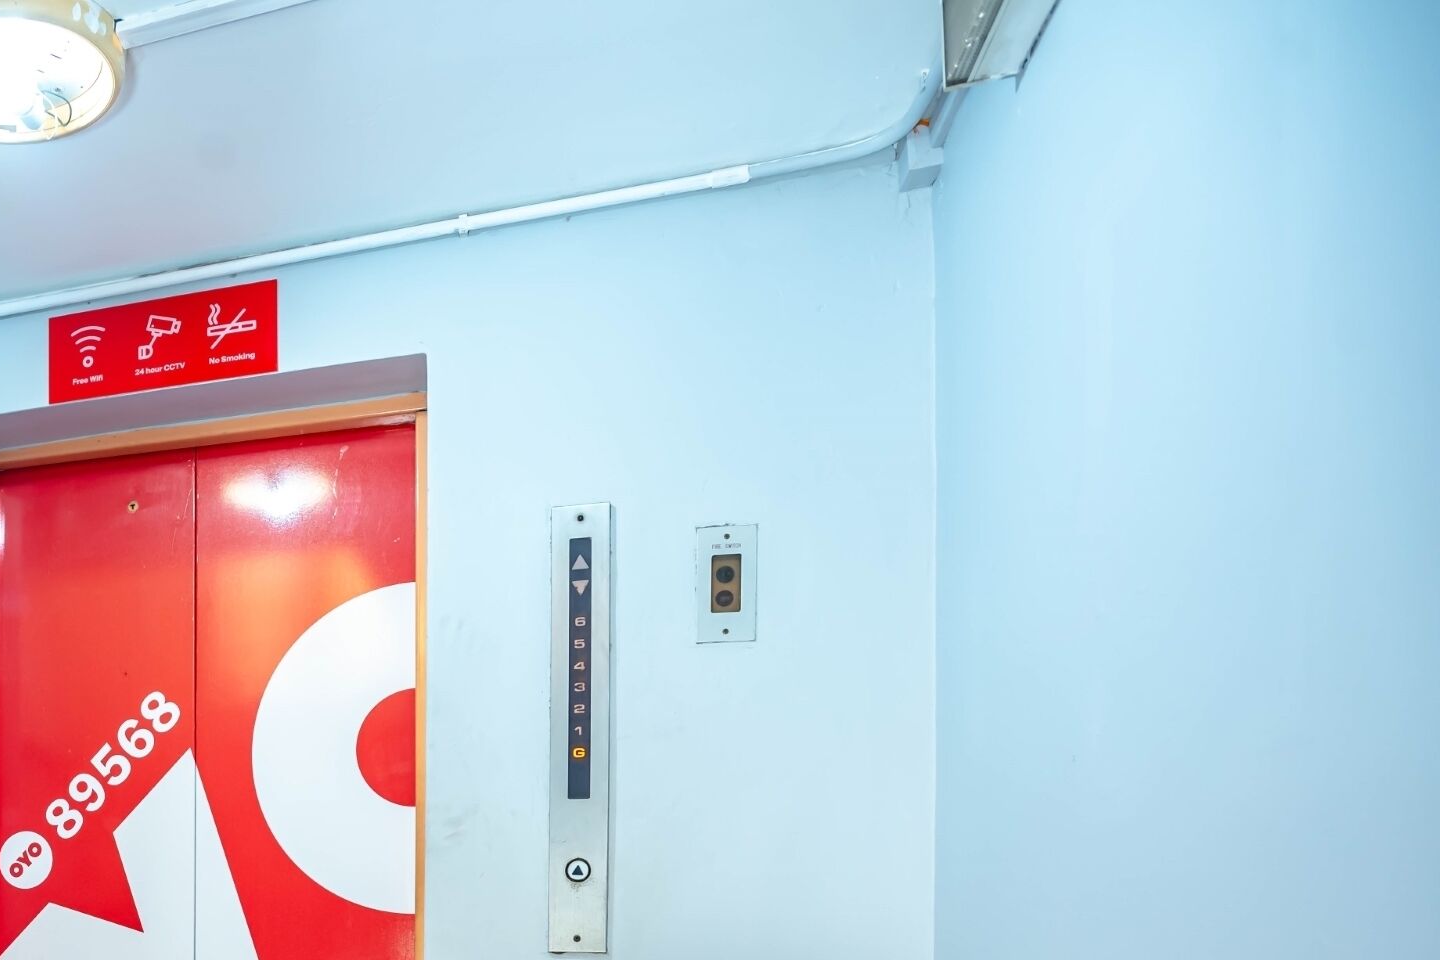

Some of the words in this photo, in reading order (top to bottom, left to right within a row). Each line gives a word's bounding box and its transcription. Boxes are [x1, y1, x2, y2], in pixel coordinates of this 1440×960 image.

[208, 357, 220, 365] No
[220, 351, 256, 364] Smoking
[134, 368, 145, 376] 24
[145, 366, 163, 375] hour
[163, 362, 186, 371] CCTV
[72, 377, 89, 386] Free
[89, 374, 104, 383] Wifi
[574, 616, 586, 627] 6
[574, 638, 585, 649] 5
[573, 661, 585, 671] 4
[573, 682, 585, 692] 3
[573, 703, 585, 714] 2
[574, 725, 583, 736] 1
[572, 747, 586, 759] G
[9, 842, 42, 878] OYO
[45, 691, 181, 840] 89568
